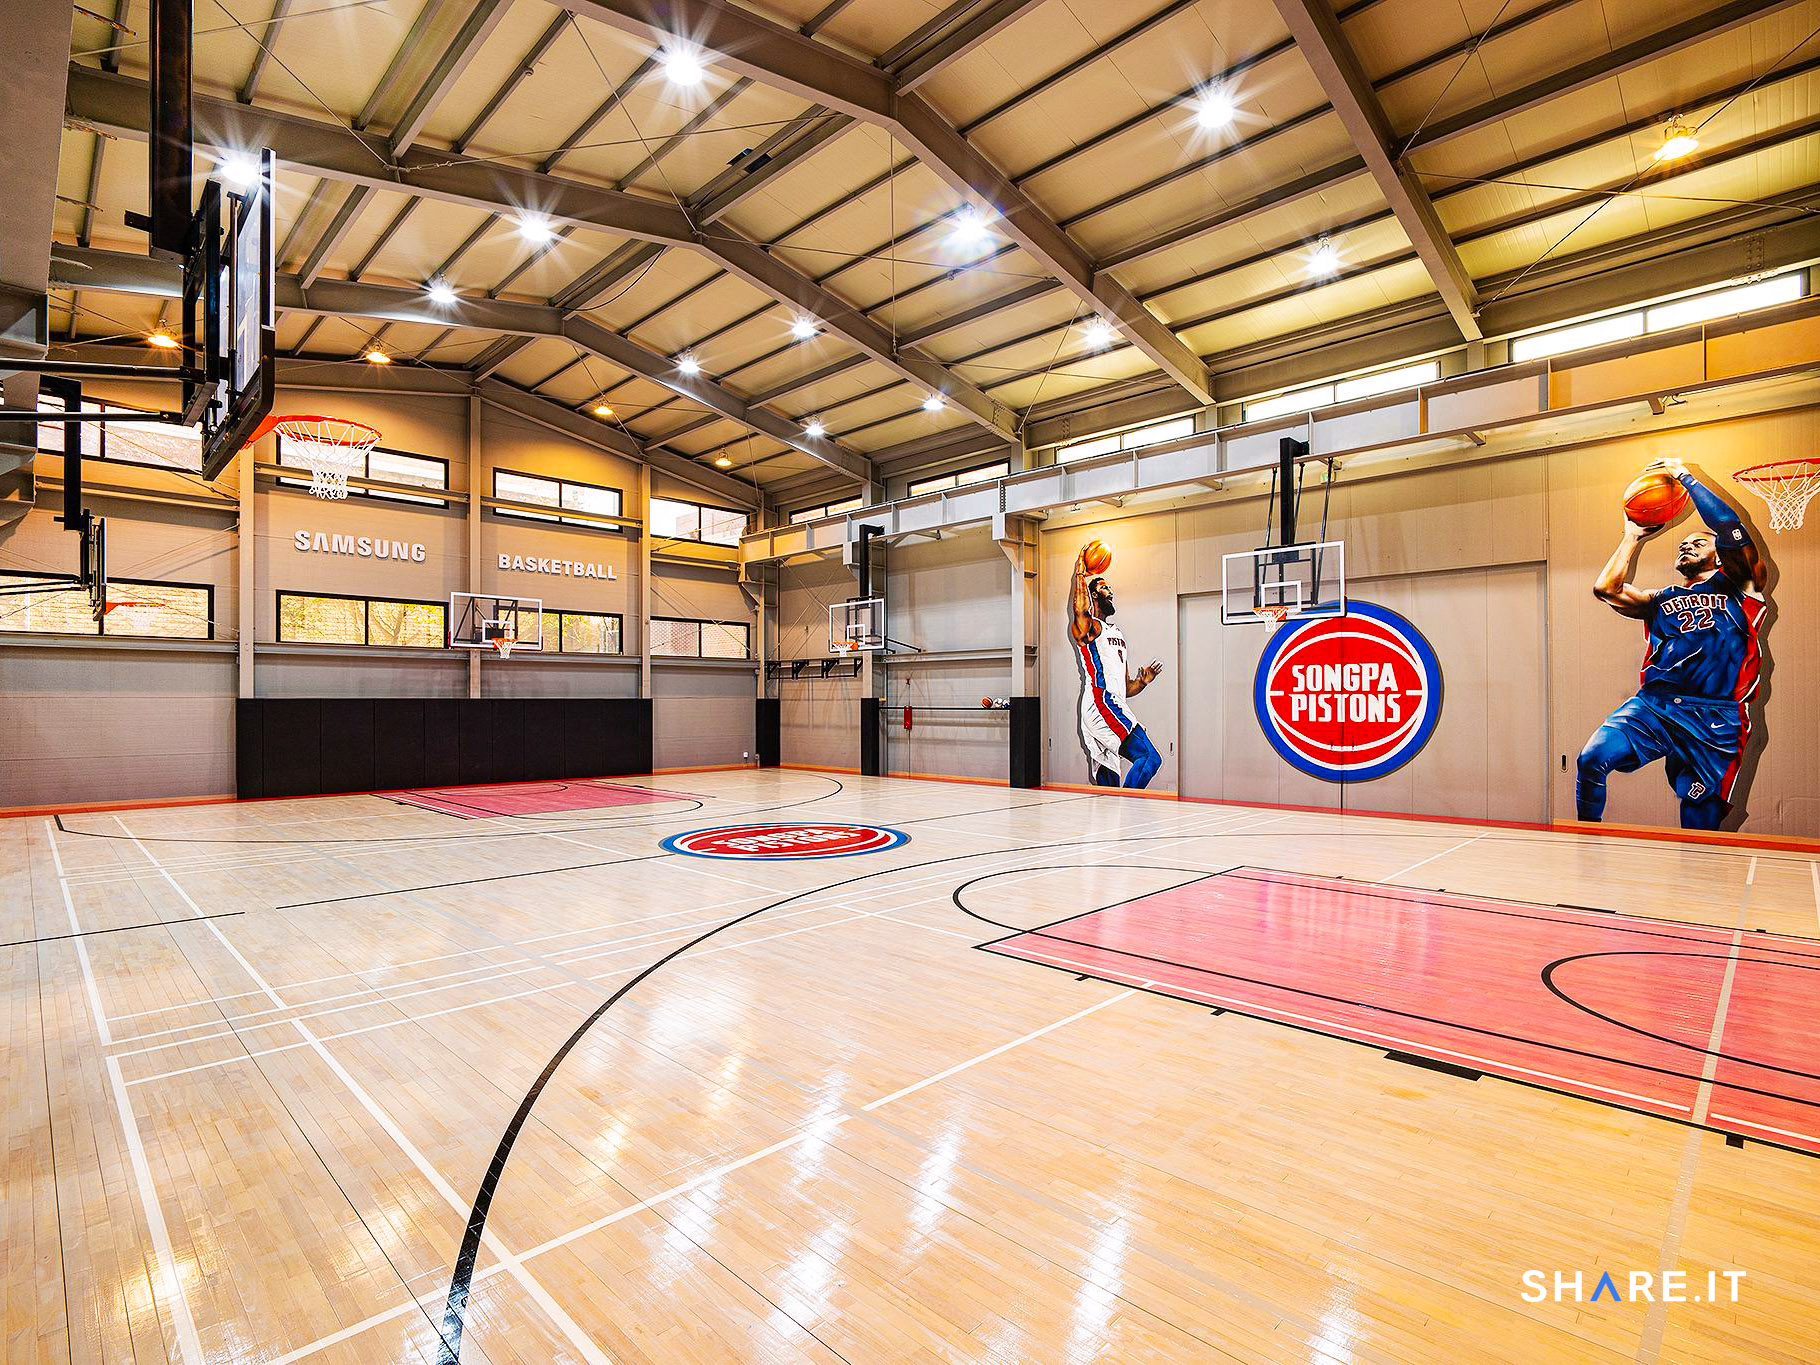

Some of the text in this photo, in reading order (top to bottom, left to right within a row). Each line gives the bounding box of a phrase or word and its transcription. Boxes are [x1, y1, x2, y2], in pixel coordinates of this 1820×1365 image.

[294, 530, 426, 563] SAMSUNG
[498, 553, 617, 581] BASKETBALL
[1660, 593, 1728, 615] DETROIT
[1678, 607, 1715, 633] 22
[1292, 663, 1399, 692] SONGPA
[1288, 693, 1401, 723] PISTONS
